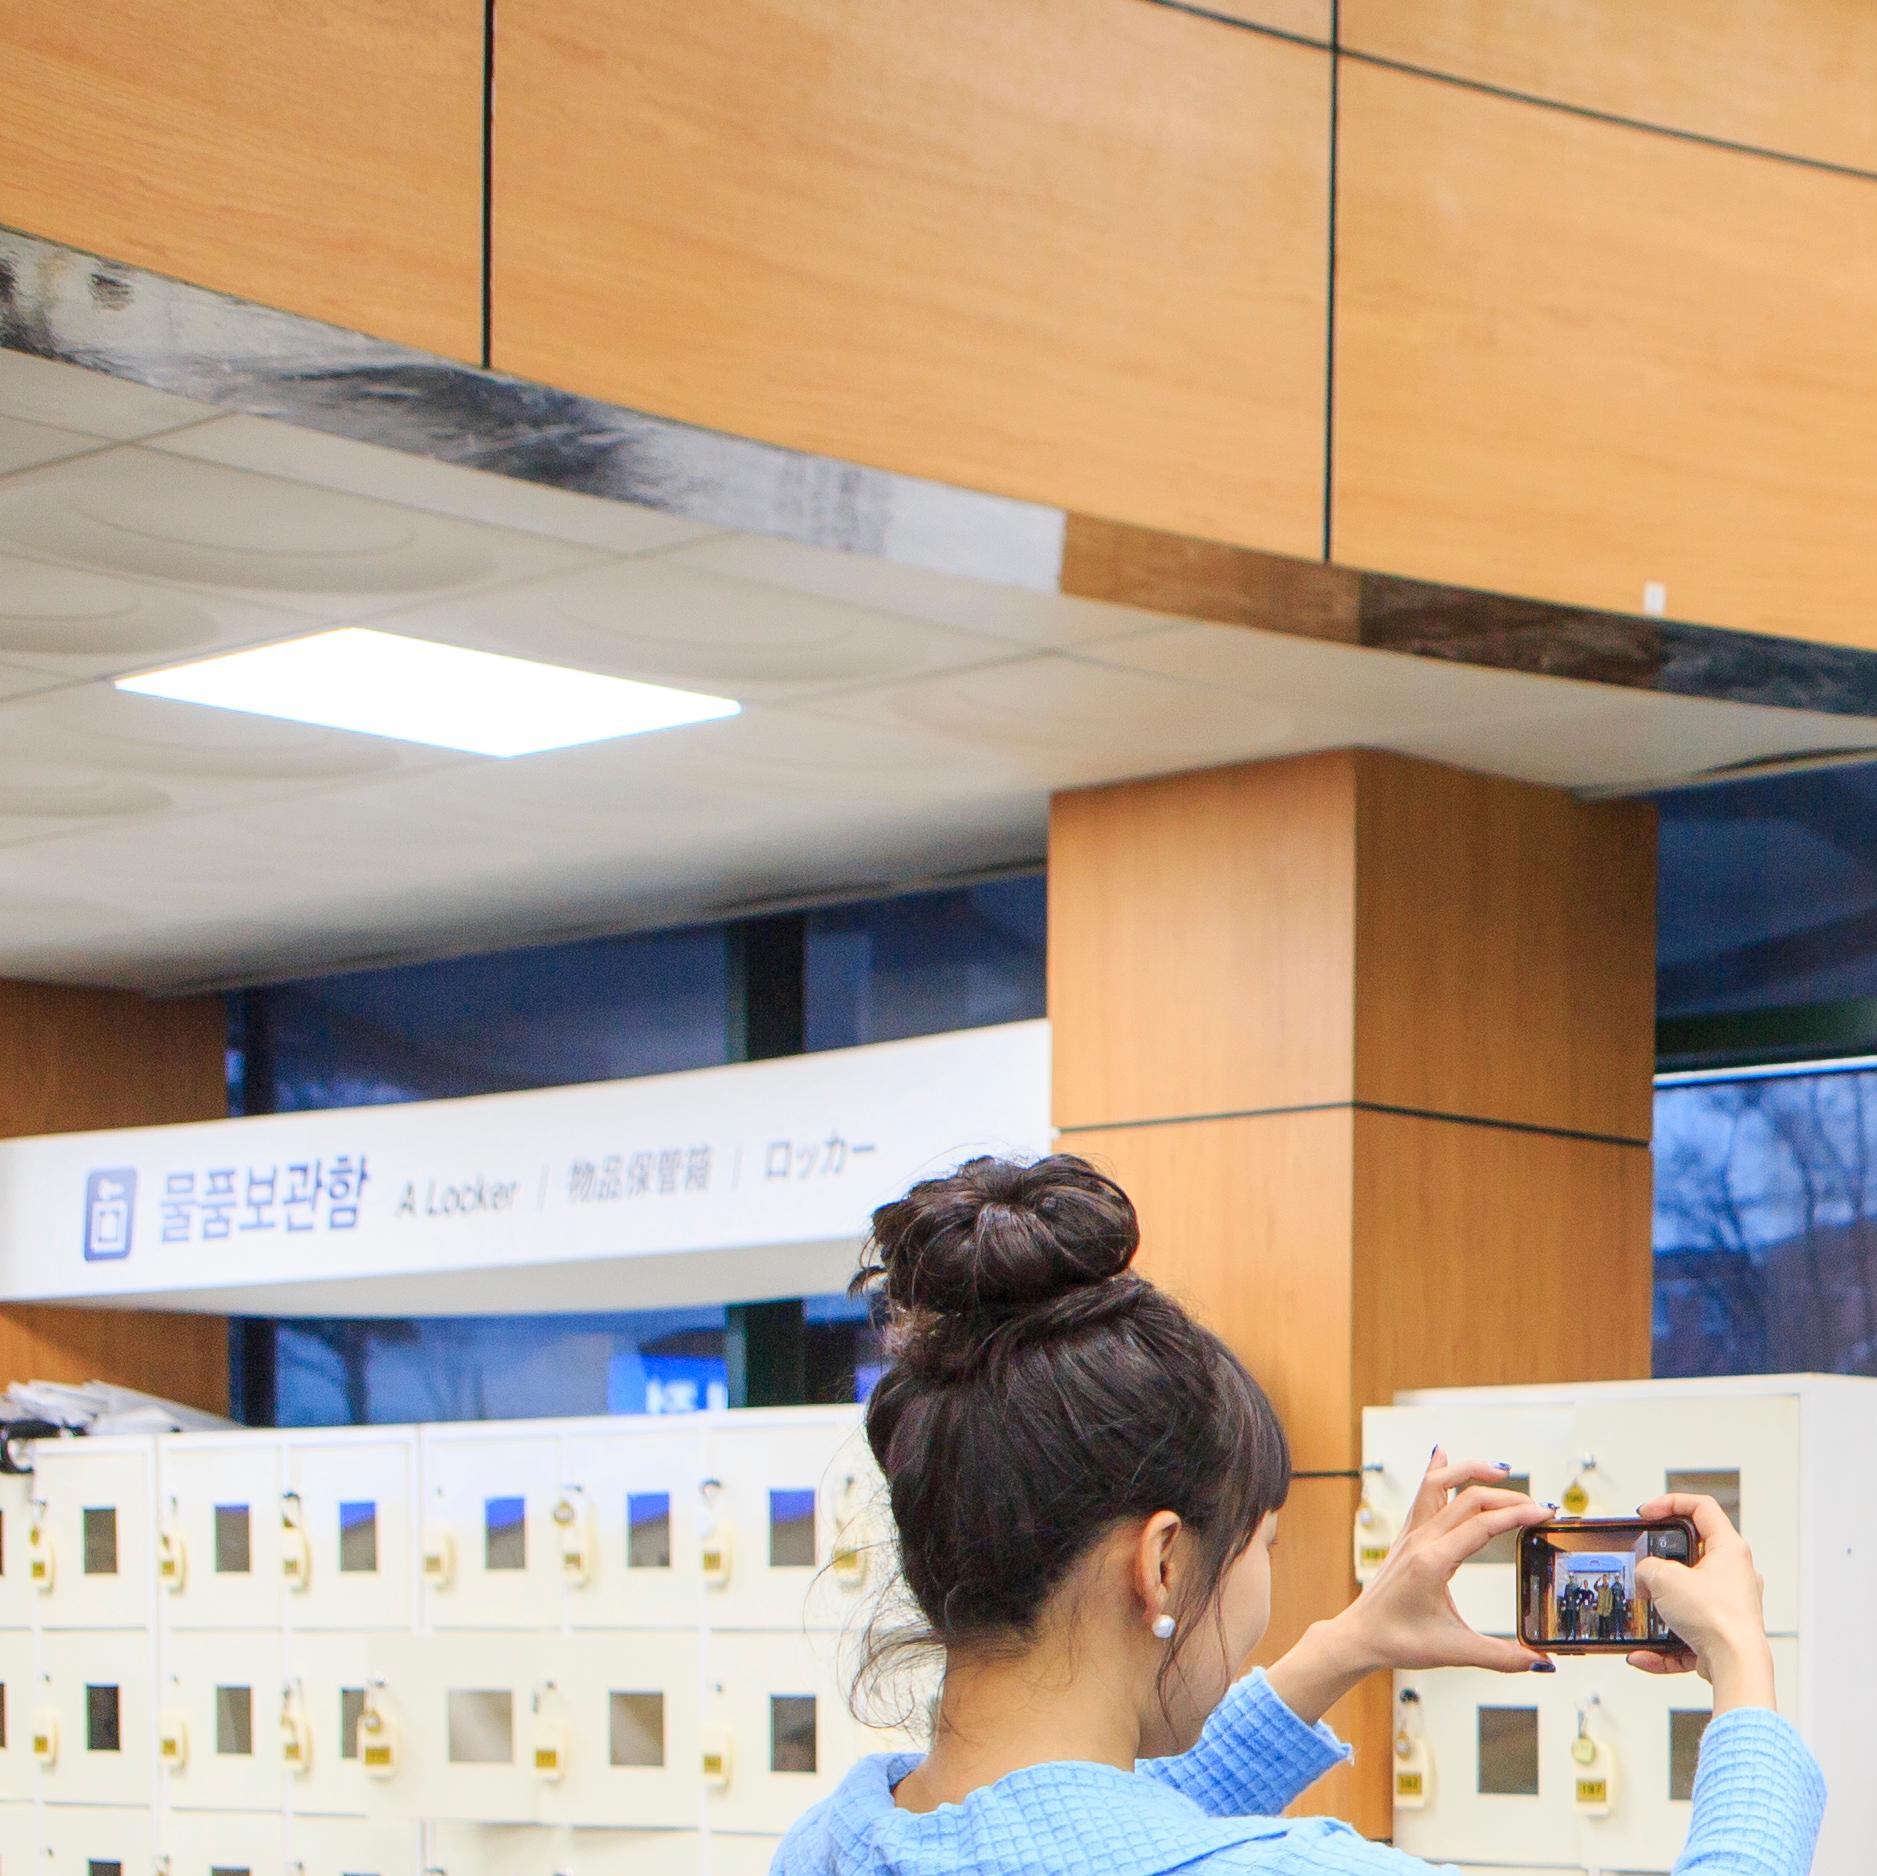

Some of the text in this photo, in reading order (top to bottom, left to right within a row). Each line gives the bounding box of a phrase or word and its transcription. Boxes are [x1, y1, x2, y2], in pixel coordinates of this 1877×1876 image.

[764, 1133, 877, 1181] ロッカー
[160, 1153, 370, 1243] 물품보관함
[424, 1173, 519, 1216] Locker
